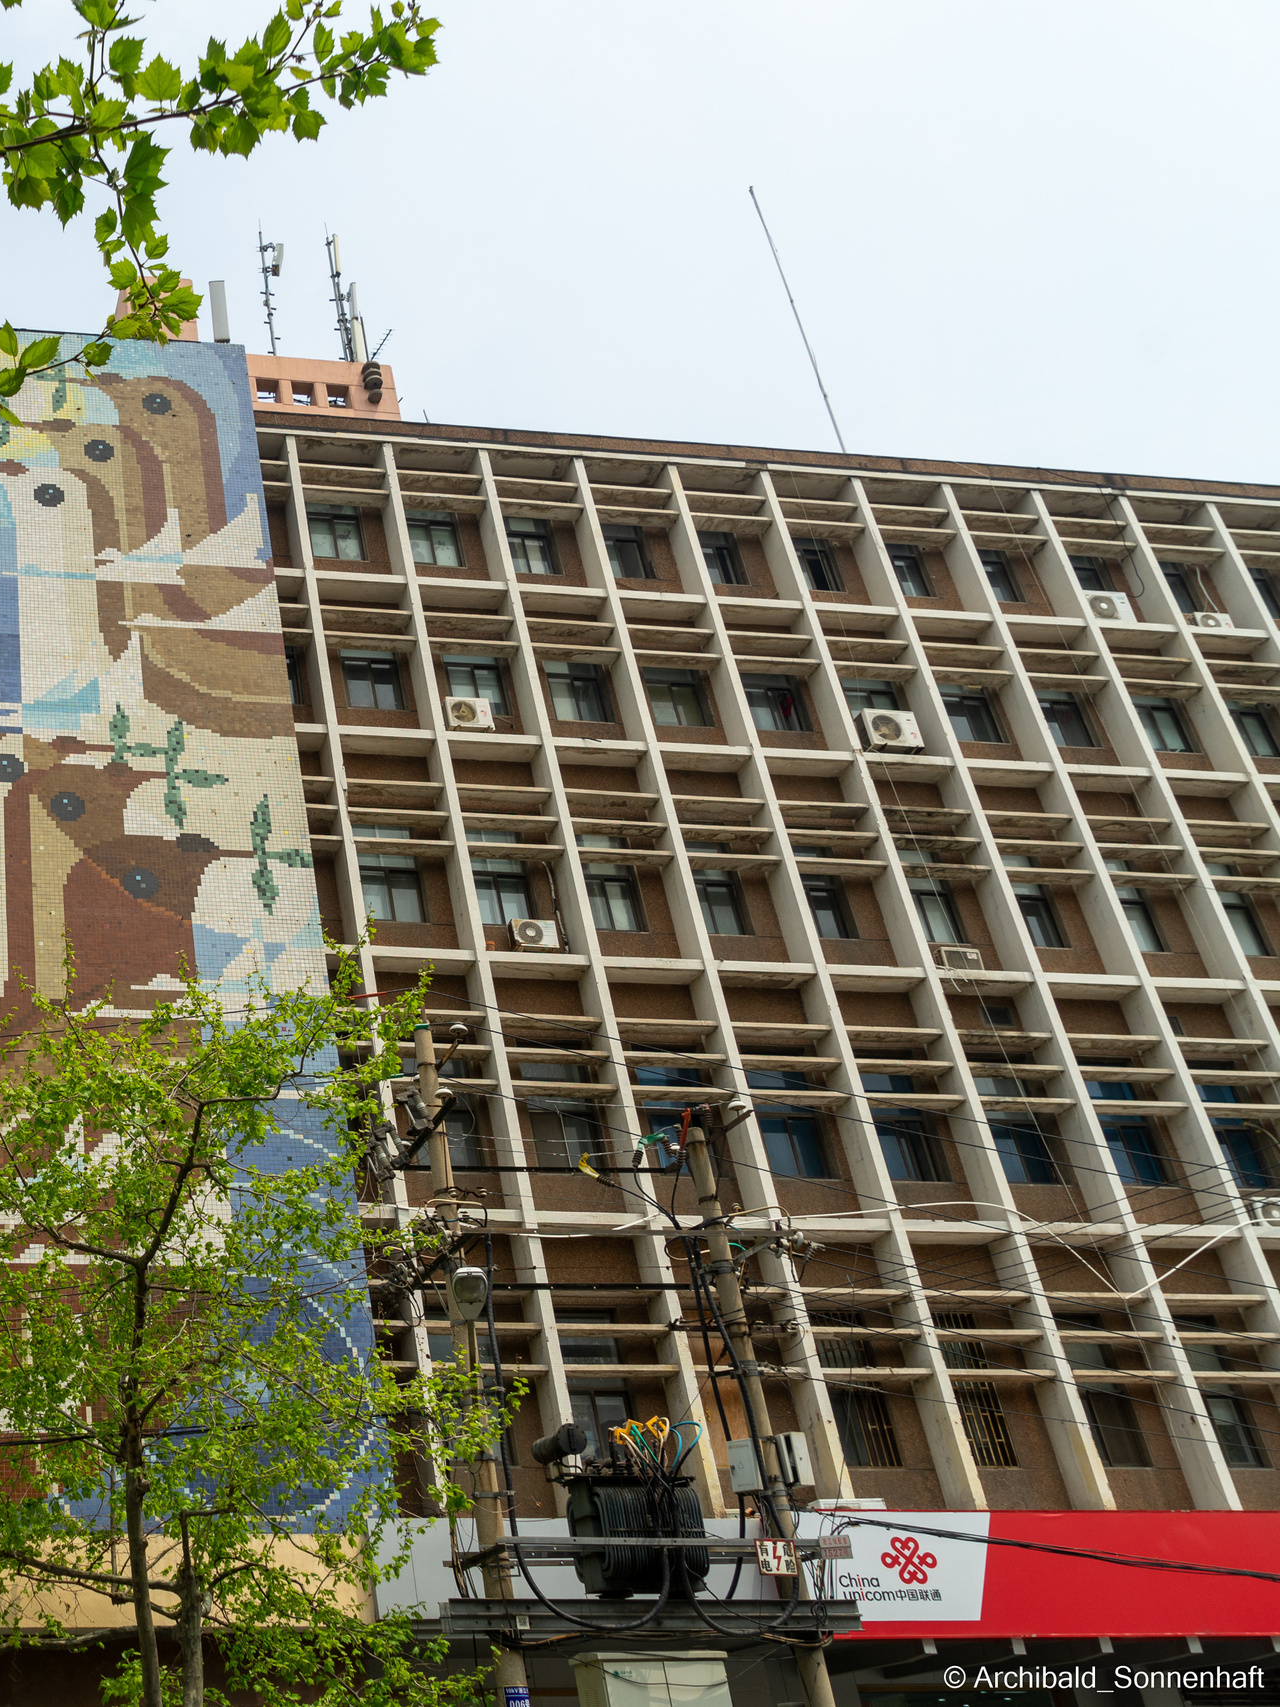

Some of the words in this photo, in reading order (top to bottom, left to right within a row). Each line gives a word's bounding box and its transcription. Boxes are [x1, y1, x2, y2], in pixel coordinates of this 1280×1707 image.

[758, 1541, 773, 1572] 有电
[782, 1541, 797, 1574] 危险
[838, 1572, 880, 1588] China
[843, 1588, 896, 1601] unicom
[895, 1588, 942, 1602] 中国联通
